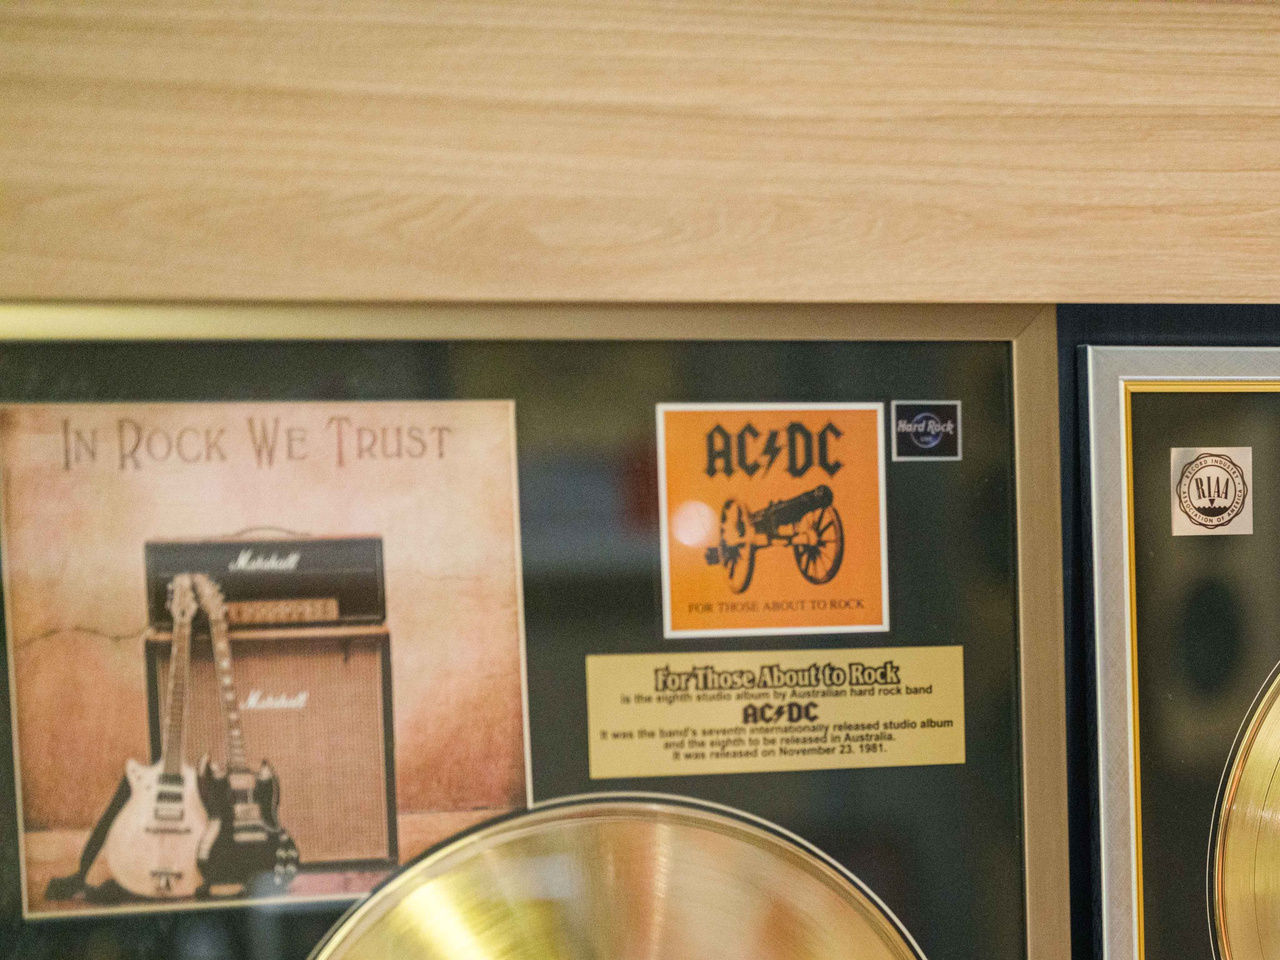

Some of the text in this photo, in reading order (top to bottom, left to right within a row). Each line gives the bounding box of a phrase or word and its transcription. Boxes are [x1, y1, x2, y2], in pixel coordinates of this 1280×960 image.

[61, 416, 454, 470] IN ROCK WE TRUST
[1211, 458, 1240, 480] INDUSTRY
[1194, 476, 1230, 500] RIAA
[1182, 490, 1214, 524] ASSOCIATION
[1227, 489, 1243, 517] AMERICA
[654, 660, 901, 692] For Those About to Rock
[790, 688, 847, 698] Australian
[850, 687, 875, 697] hard
[878, 685, 902, 696] rock
[905, 684, 933, 695] band
[832, 720, 880, 732] released
[883, 718, 917, 730] studio
[920, 718, 953, 728] album
[779, 744, 836, 756] November
[780, 733, 827, 746] released
